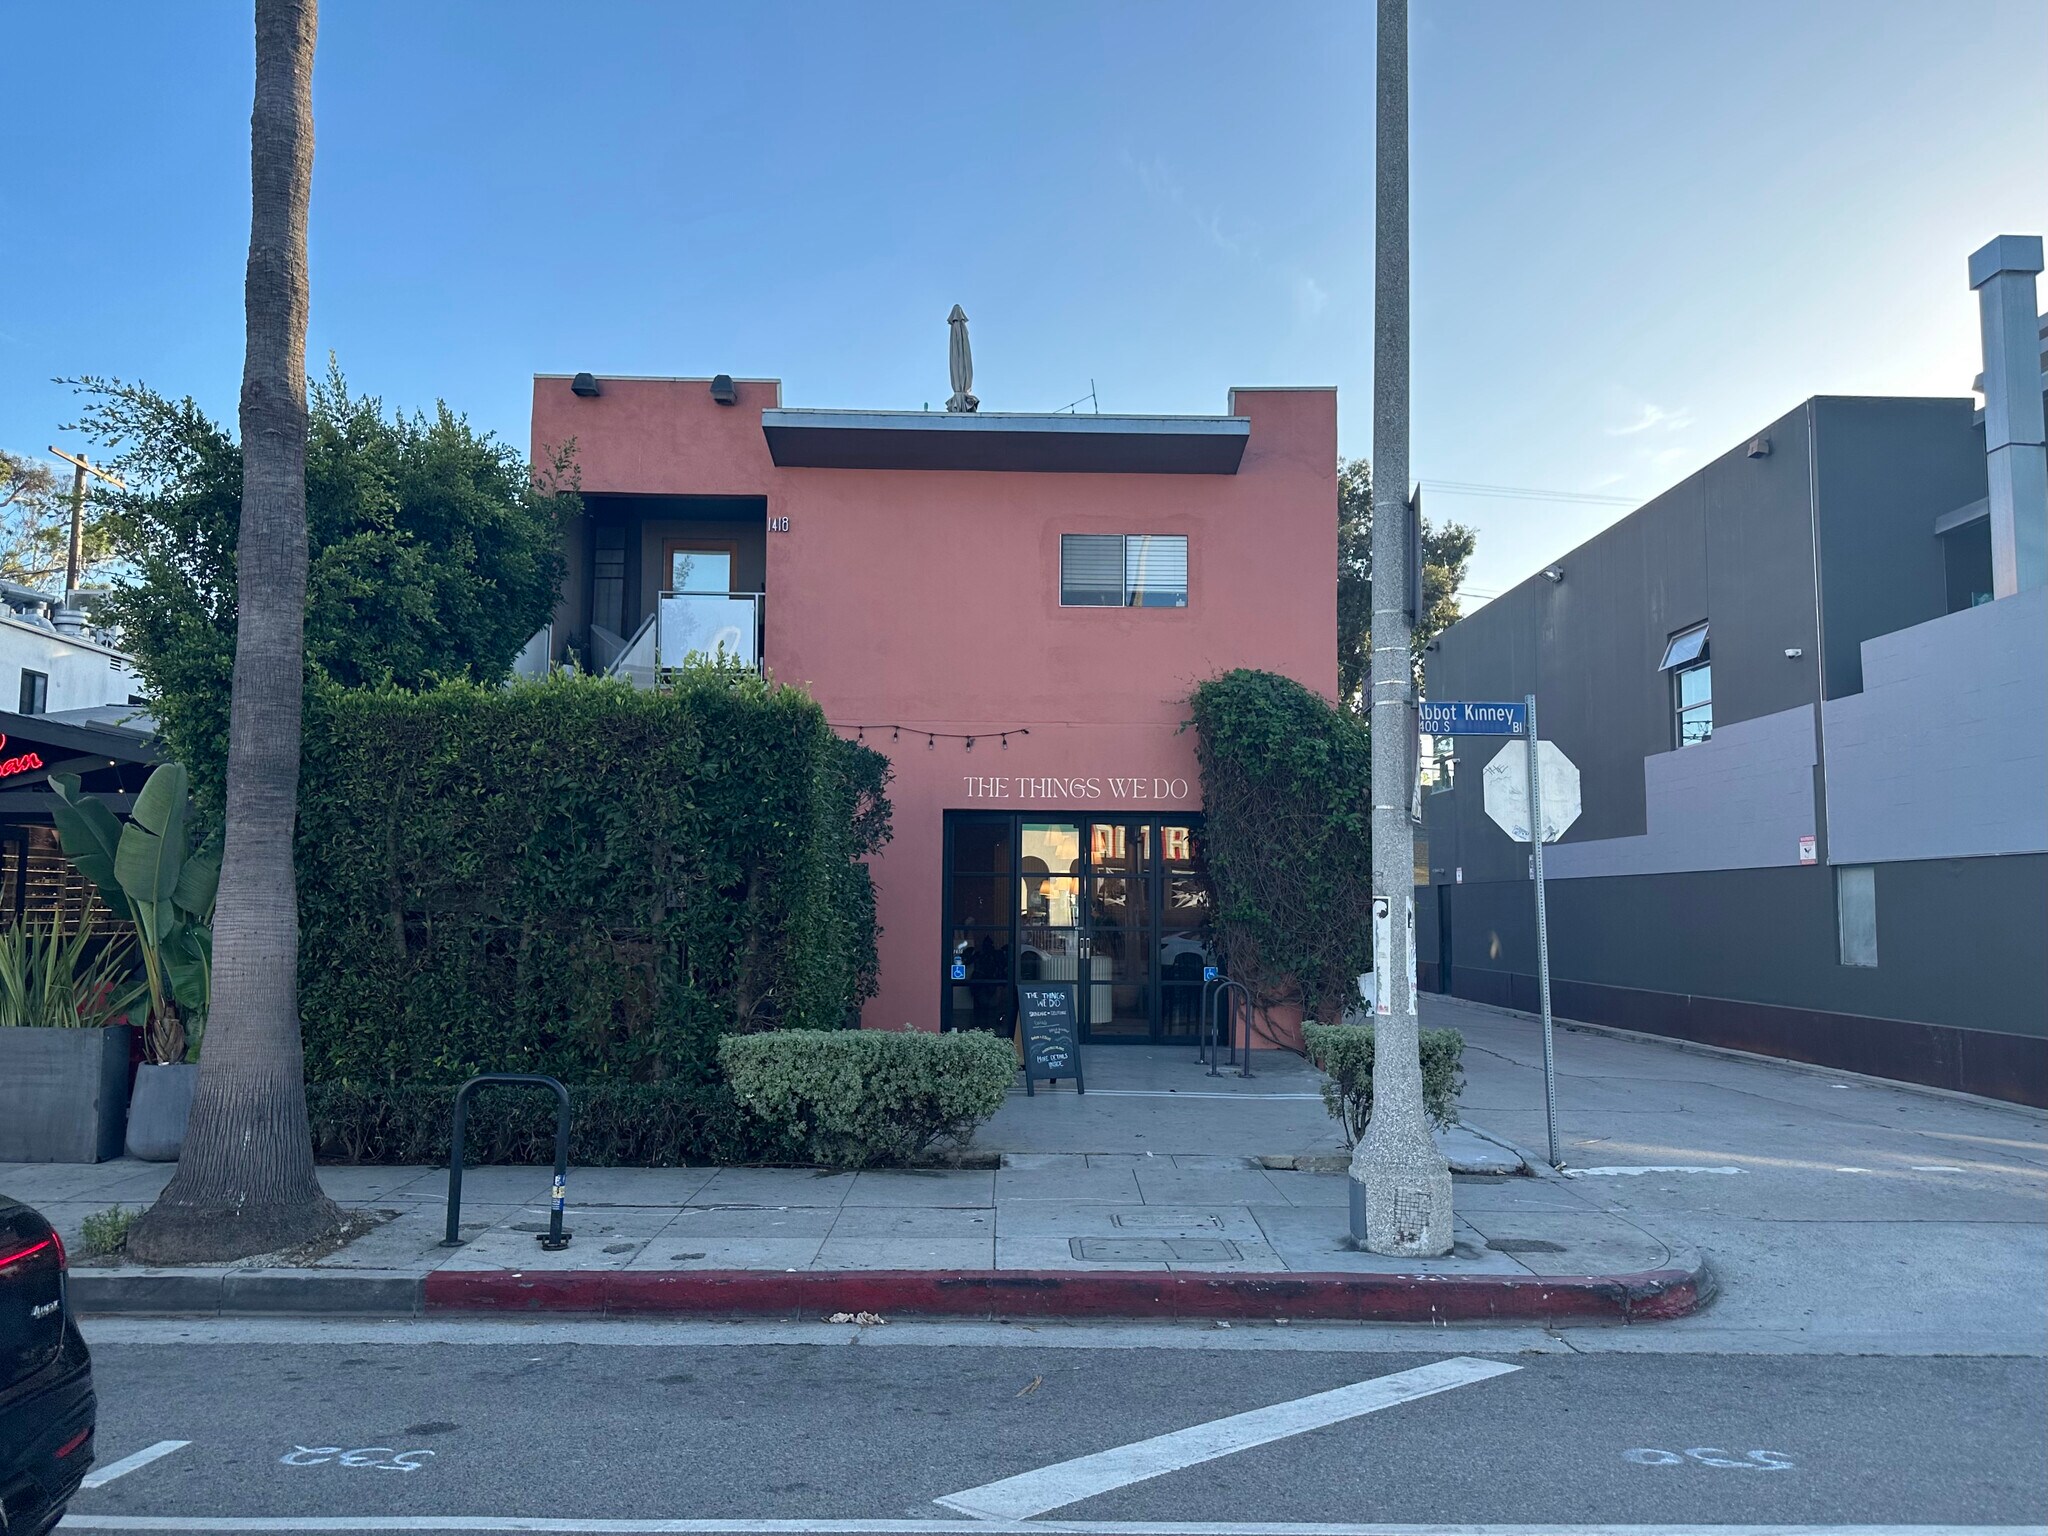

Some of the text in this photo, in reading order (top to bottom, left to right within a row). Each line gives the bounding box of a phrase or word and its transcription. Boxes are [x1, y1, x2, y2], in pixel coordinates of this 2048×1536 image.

[768, 516, 789, 532] 1418
[1464, 704, 1514, 725] Kinney
[1444, 720, 1450, 732] S
[964, 776, 1189, 799] THE THINGS WE DO
[1036, 999, 1061, 1007] WE DO
[1041, 992, 1065, 1000] THINGS
